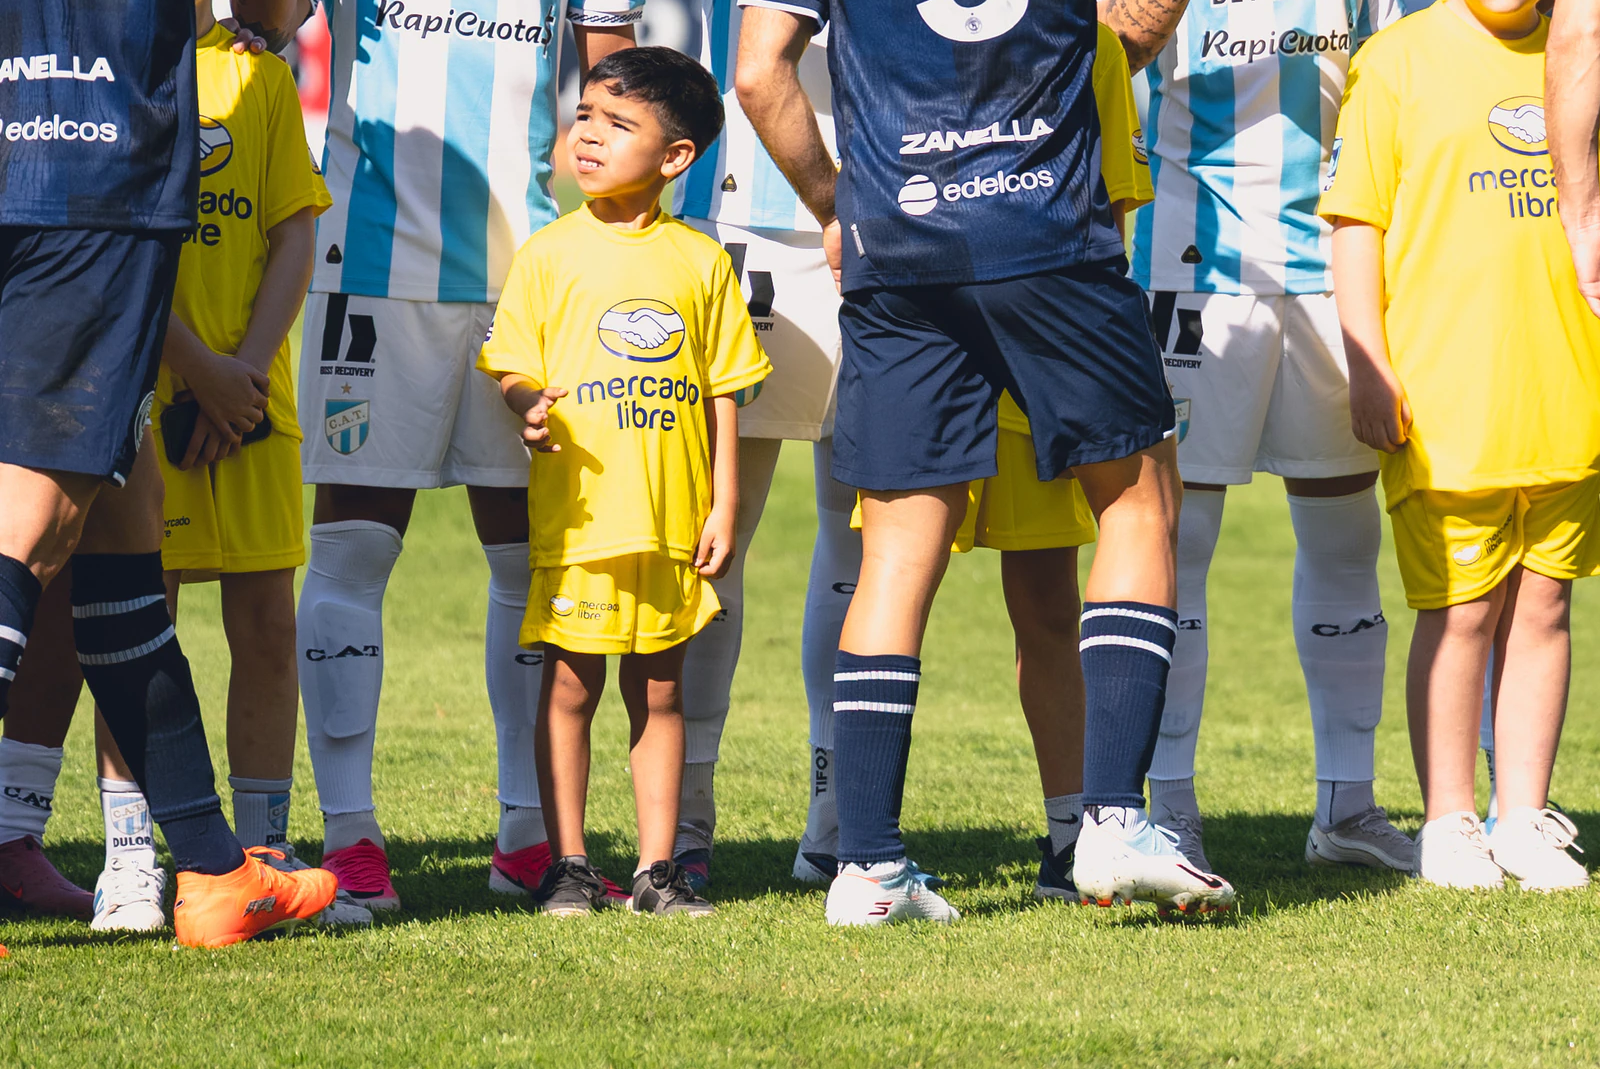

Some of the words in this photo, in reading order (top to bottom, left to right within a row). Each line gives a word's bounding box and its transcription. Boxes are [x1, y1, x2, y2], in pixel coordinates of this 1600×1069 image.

[5, 114, 119, 143] edelcos
[898, 117, 1055, 155] ZANELLA
[942, 168, 1055, 203] edelcos
[1508, 193, 1560, 219] libr
[320, 365, 334, 376] BOSS
[334, 365, 376, 378] RECOVERY
[1163, 357, 1202, 370] RECOVERY
[577, 374, 699, 406] mercado
[328, 408, 366, 431] C.A.T.
[617, 403, 676, 432] libre
[577, 609, 601, 620] libre
